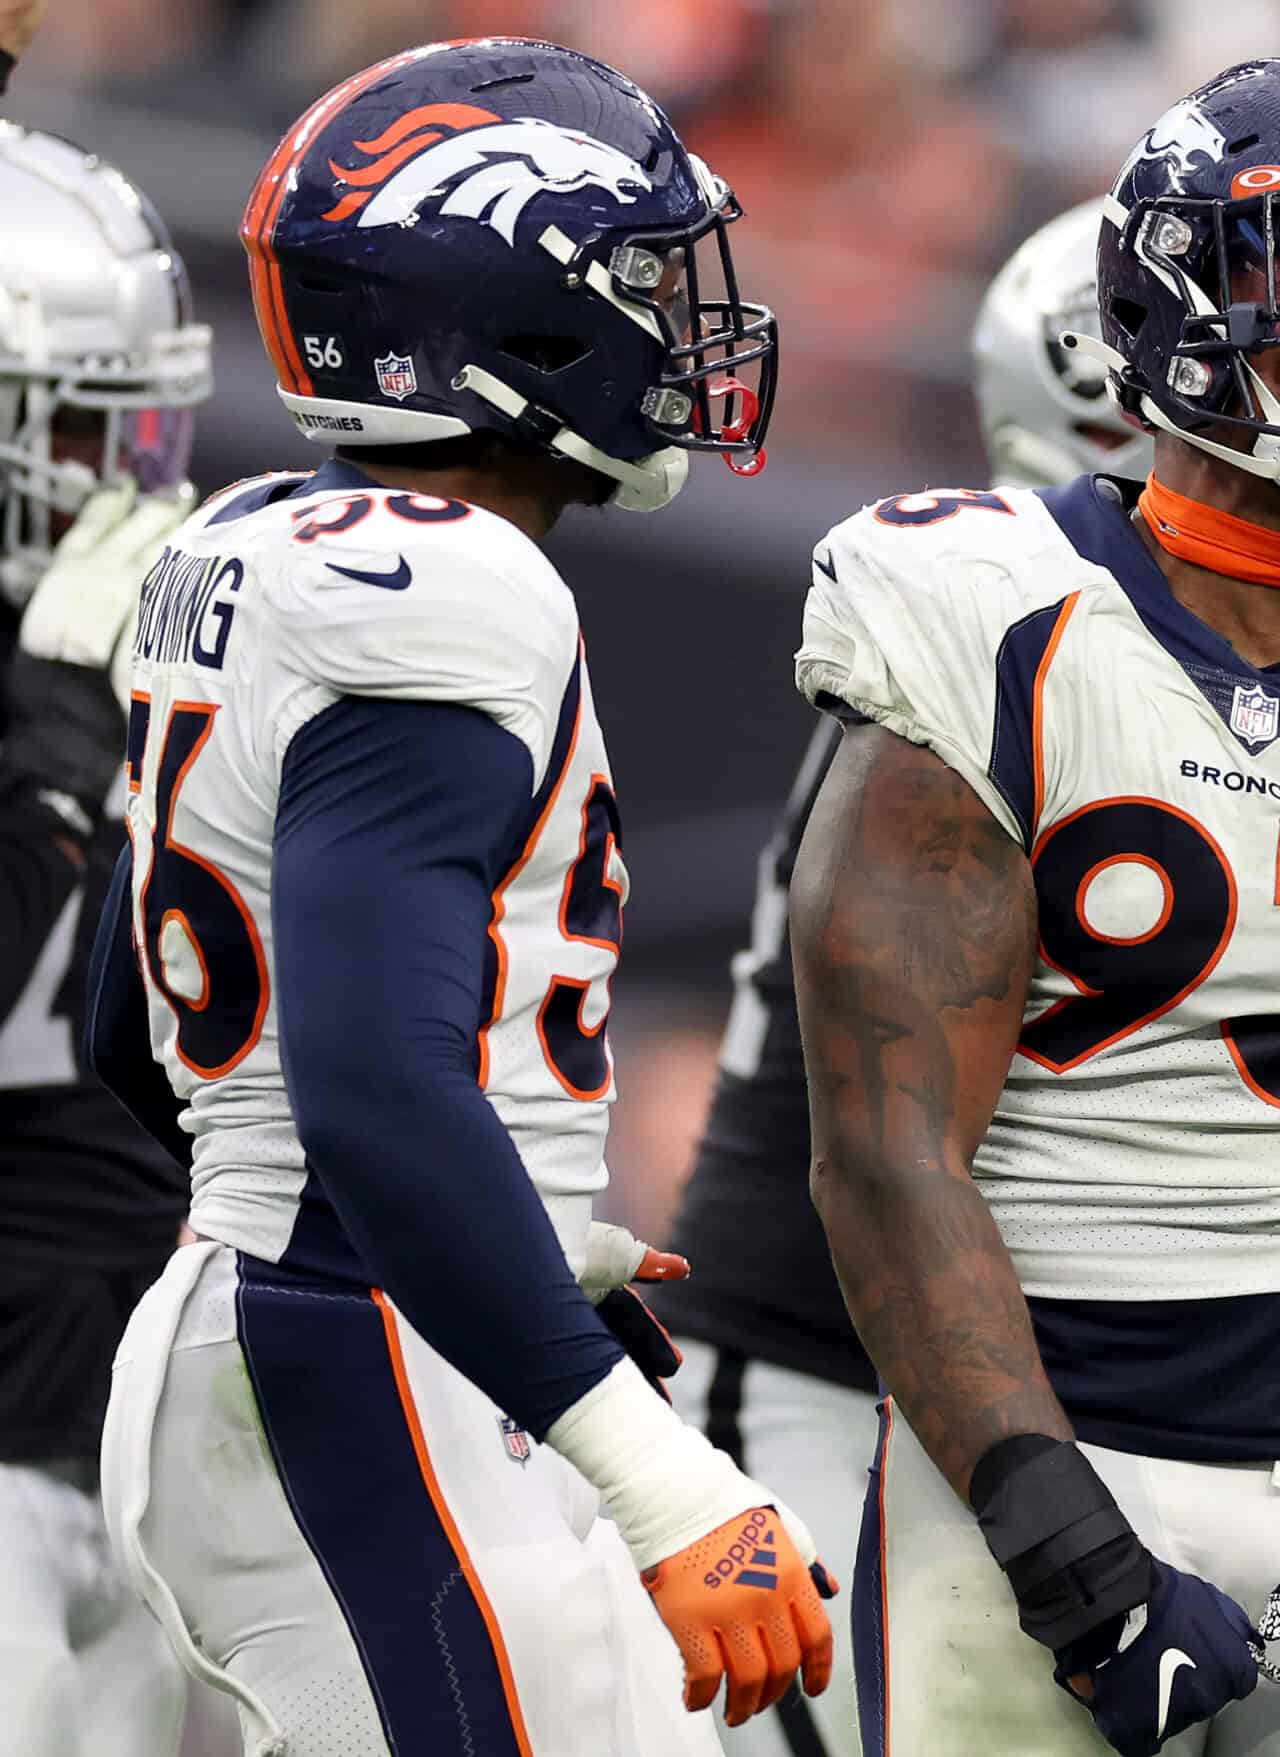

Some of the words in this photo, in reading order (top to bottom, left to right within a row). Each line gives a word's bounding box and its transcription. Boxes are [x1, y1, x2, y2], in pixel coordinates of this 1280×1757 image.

[304, 336, 342, 369] 56
[384, 373, 412, 391] NFL
[1238, 707, 1270, 733] NFL
[704, 1511, 767, 1589] adidas
